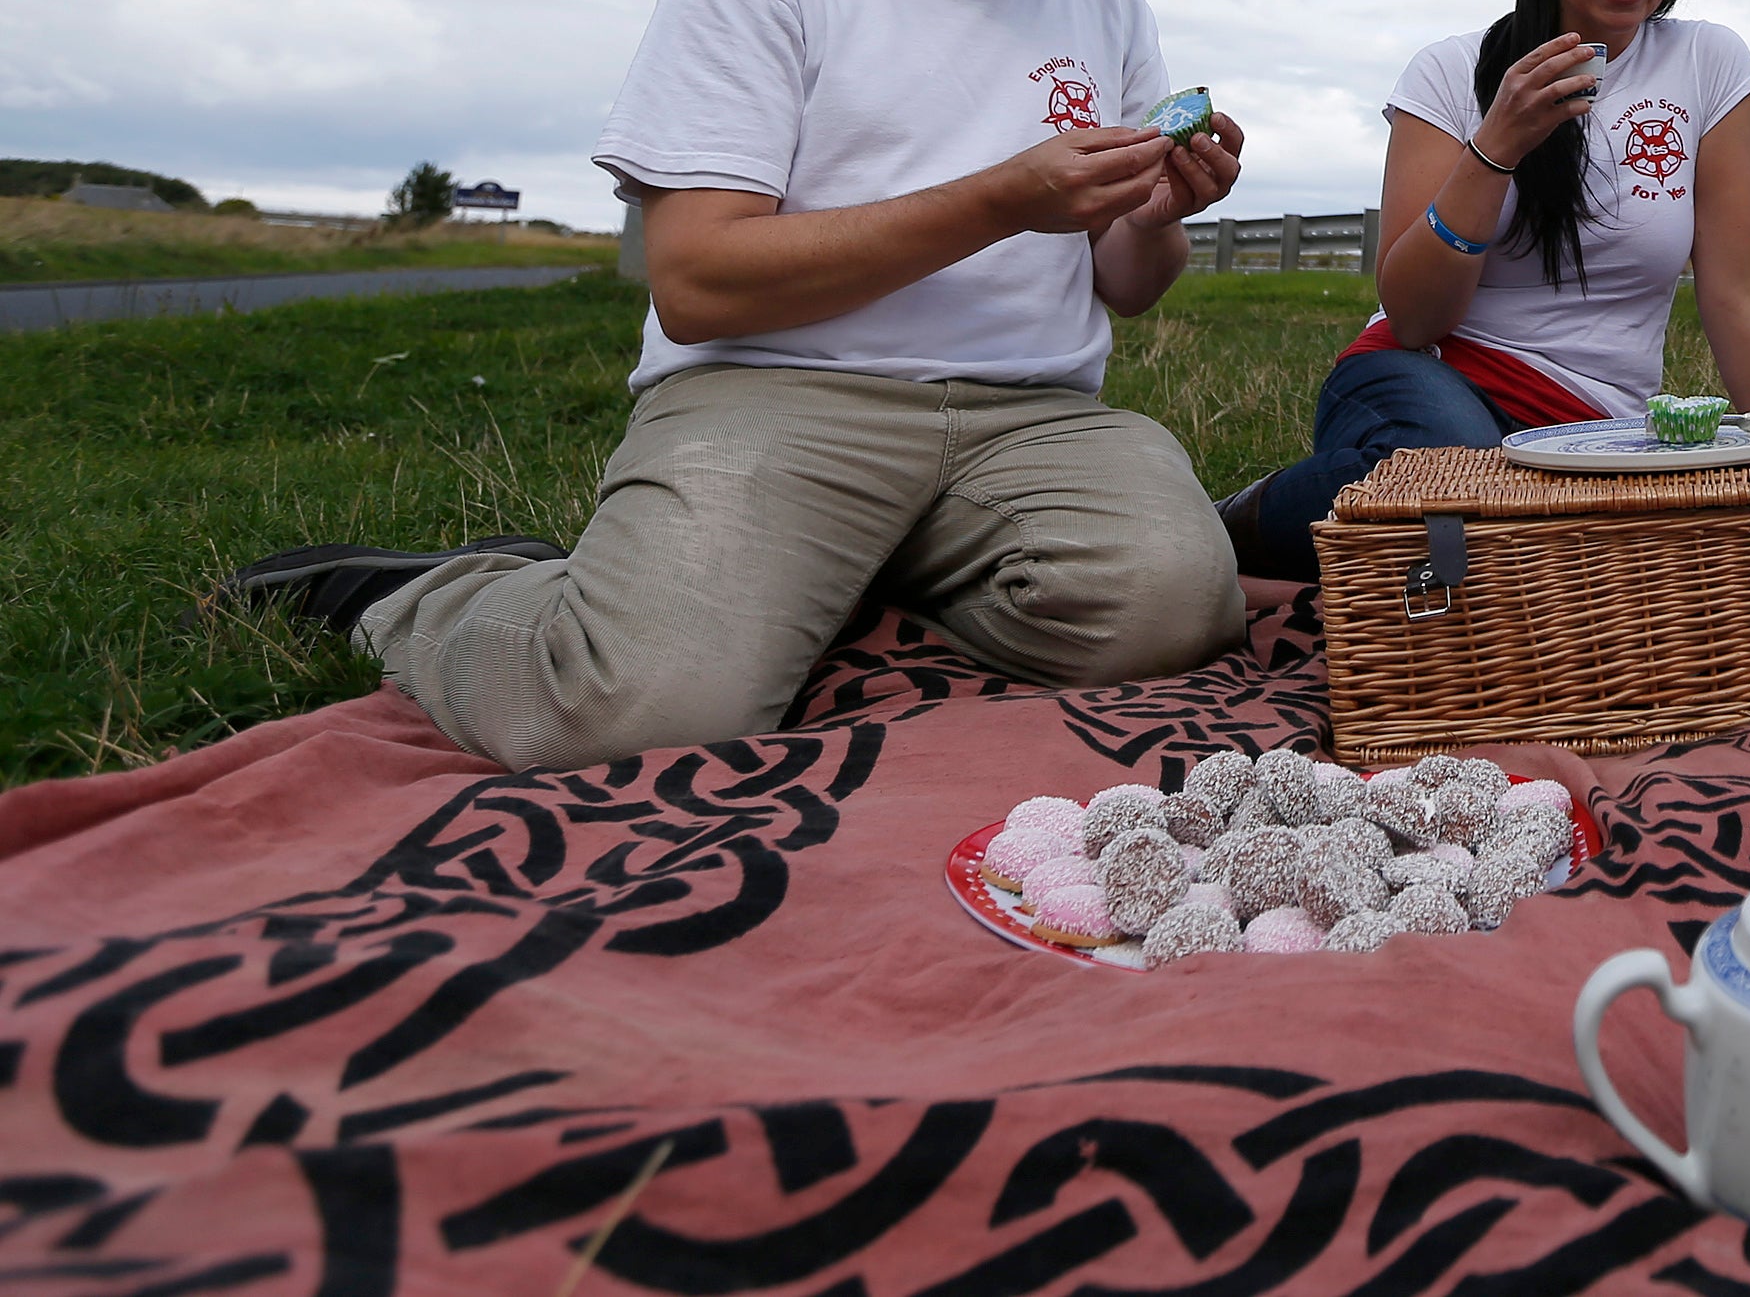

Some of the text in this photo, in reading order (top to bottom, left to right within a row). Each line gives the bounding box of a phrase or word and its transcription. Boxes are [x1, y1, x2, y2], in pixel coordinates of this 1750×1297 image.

[1028, 56, 1075, 83] English
[1067, 105, 1091, 122] Yes
[1610, 98, 1691, 131] English Scots
[1642, 144, 1669, 157] Yes
[1666, 186, 1686, 201] Yes
